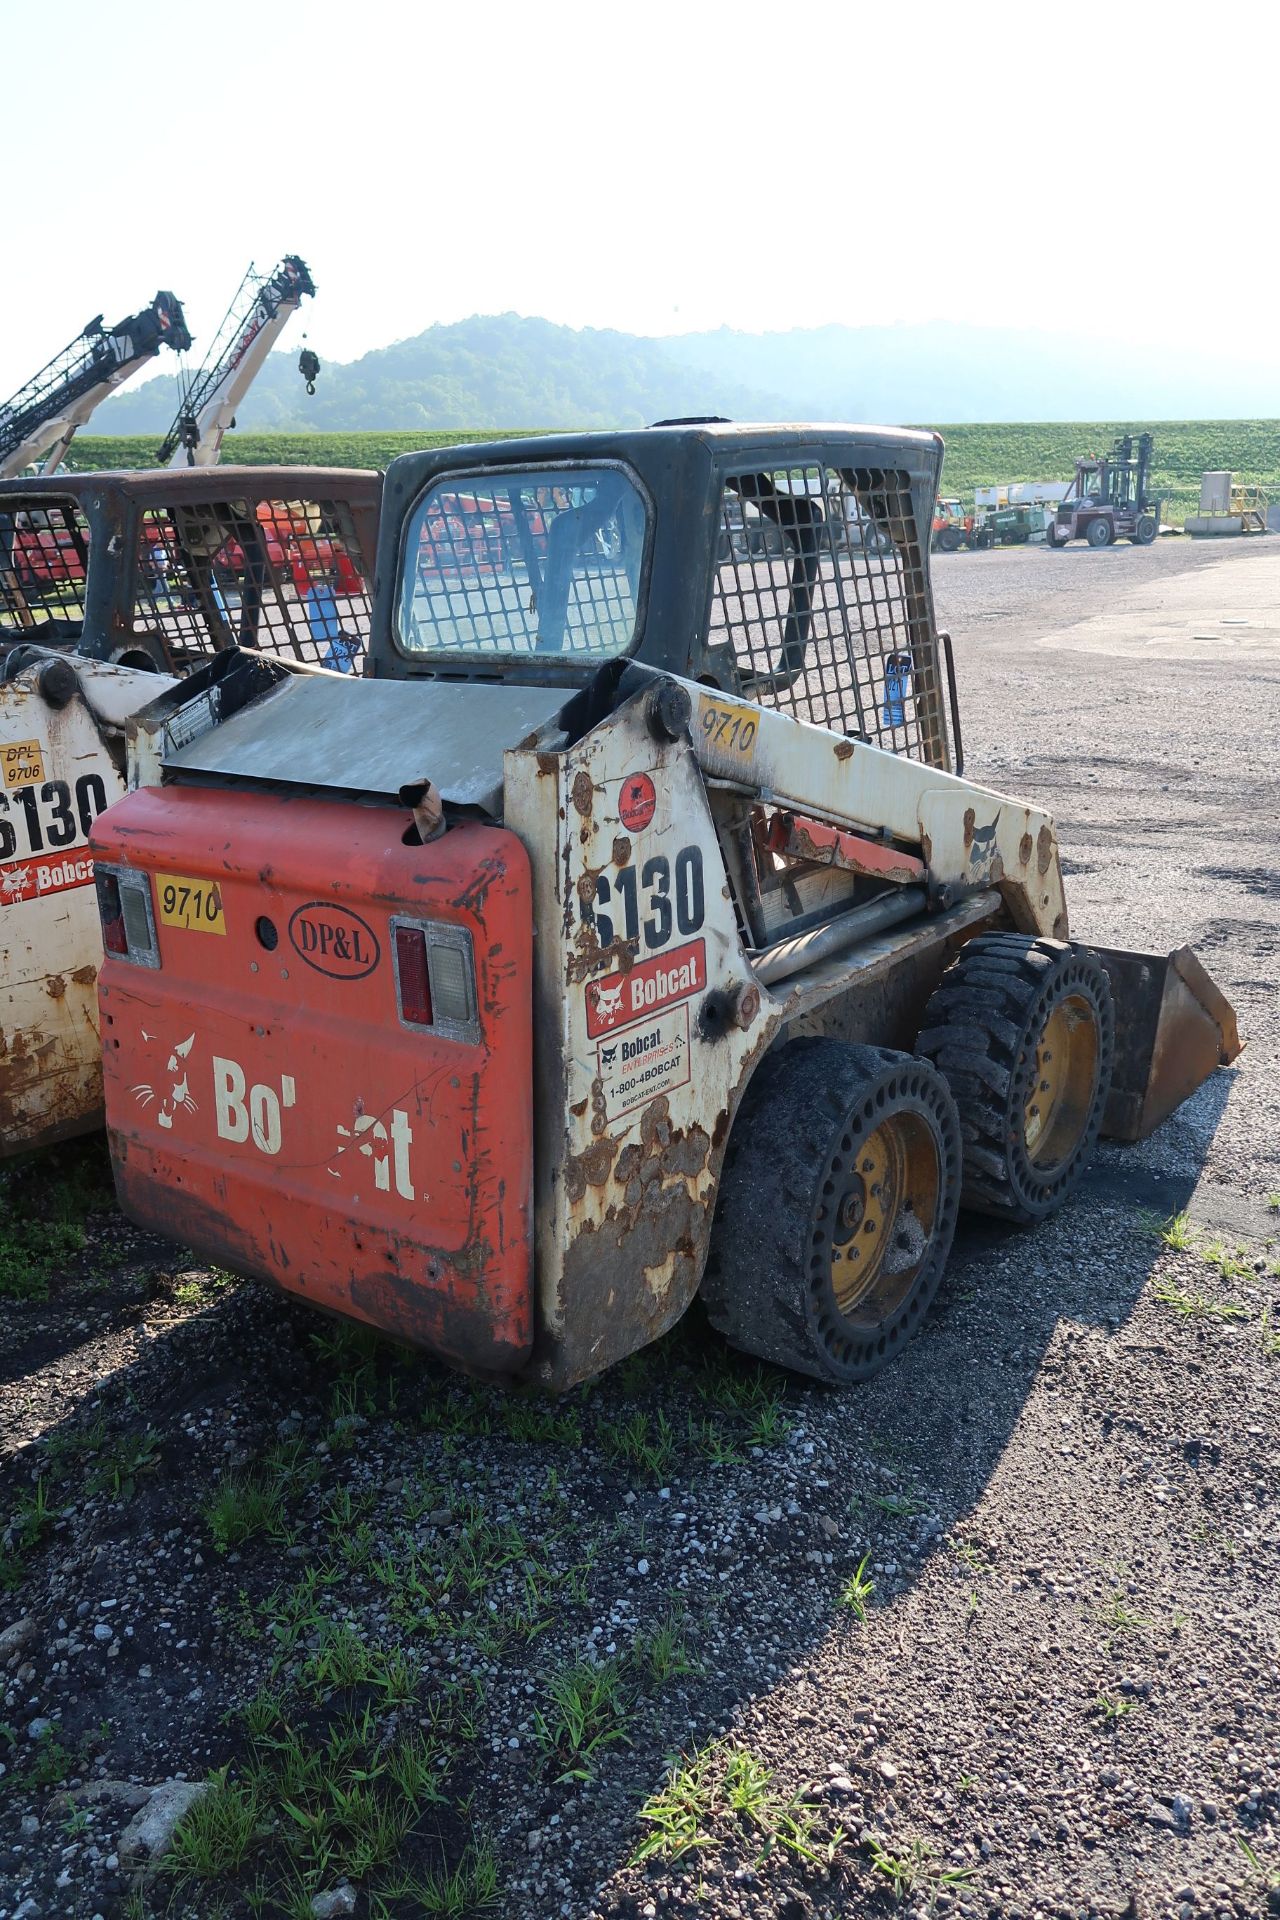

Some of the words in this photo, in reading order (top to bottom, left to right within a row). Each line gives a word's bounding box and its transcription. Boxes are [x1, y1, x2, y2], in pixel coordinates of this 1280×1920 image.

[703, 708, 755, 752] 9710
[6, 745, 35, 762] DPL
[8, 765, 40, 782] 9706
[37, 858, 95, 890] Bobca
[163, 885, 219, 921] 9710
[579, 845, 704, 970] S130
[300, 919, 370, 964] DP&L
[631, 957, 698, 1011] Bobcat
[621, 1028, 661, 1062] Bobcat
[610, 1056, 681, 1098] 1-800-4BOBCAT
[622, 1079, 671, 1107] BOBCAT-ENT.COM
